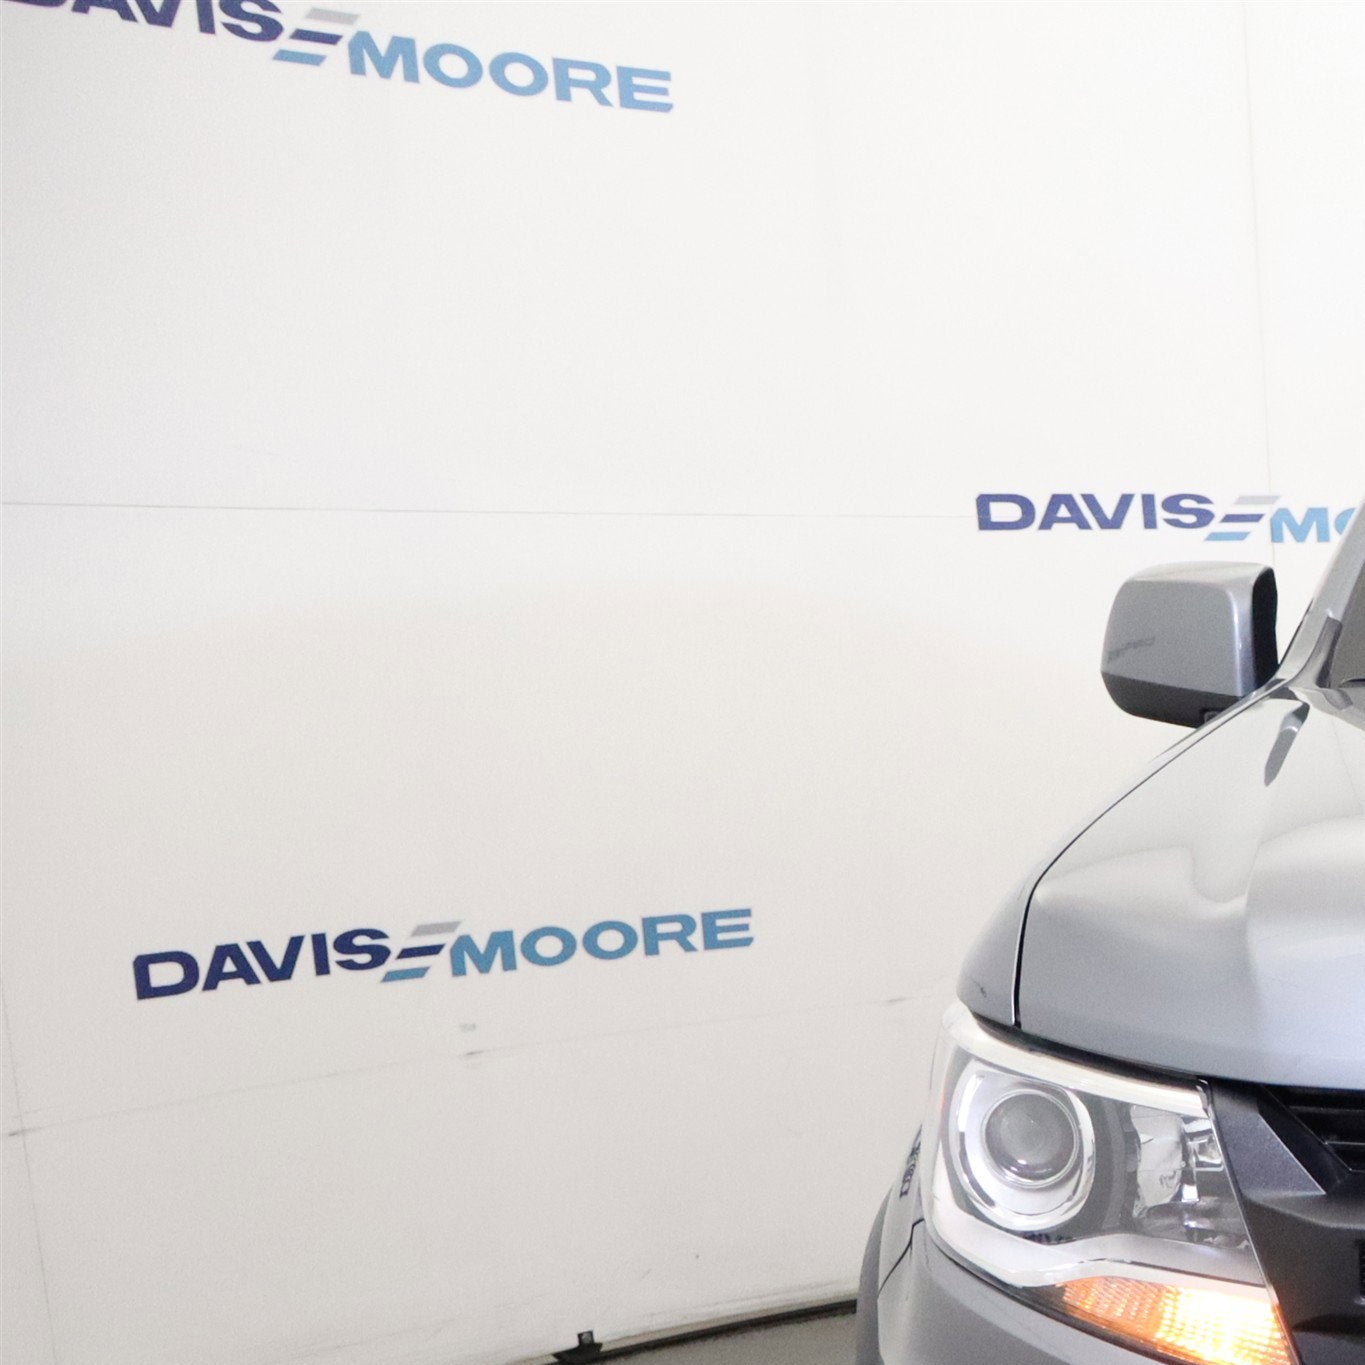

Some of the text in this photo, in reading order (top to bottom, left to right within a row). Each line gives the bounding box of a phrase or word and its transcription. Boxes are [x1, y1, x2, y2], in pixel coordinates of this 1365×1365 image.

[347, 31, 674, 113] MOORE
[975, 493, 1215, 531] DAVIS
[133, 908, 754, 1001] DAVIS MOORE
